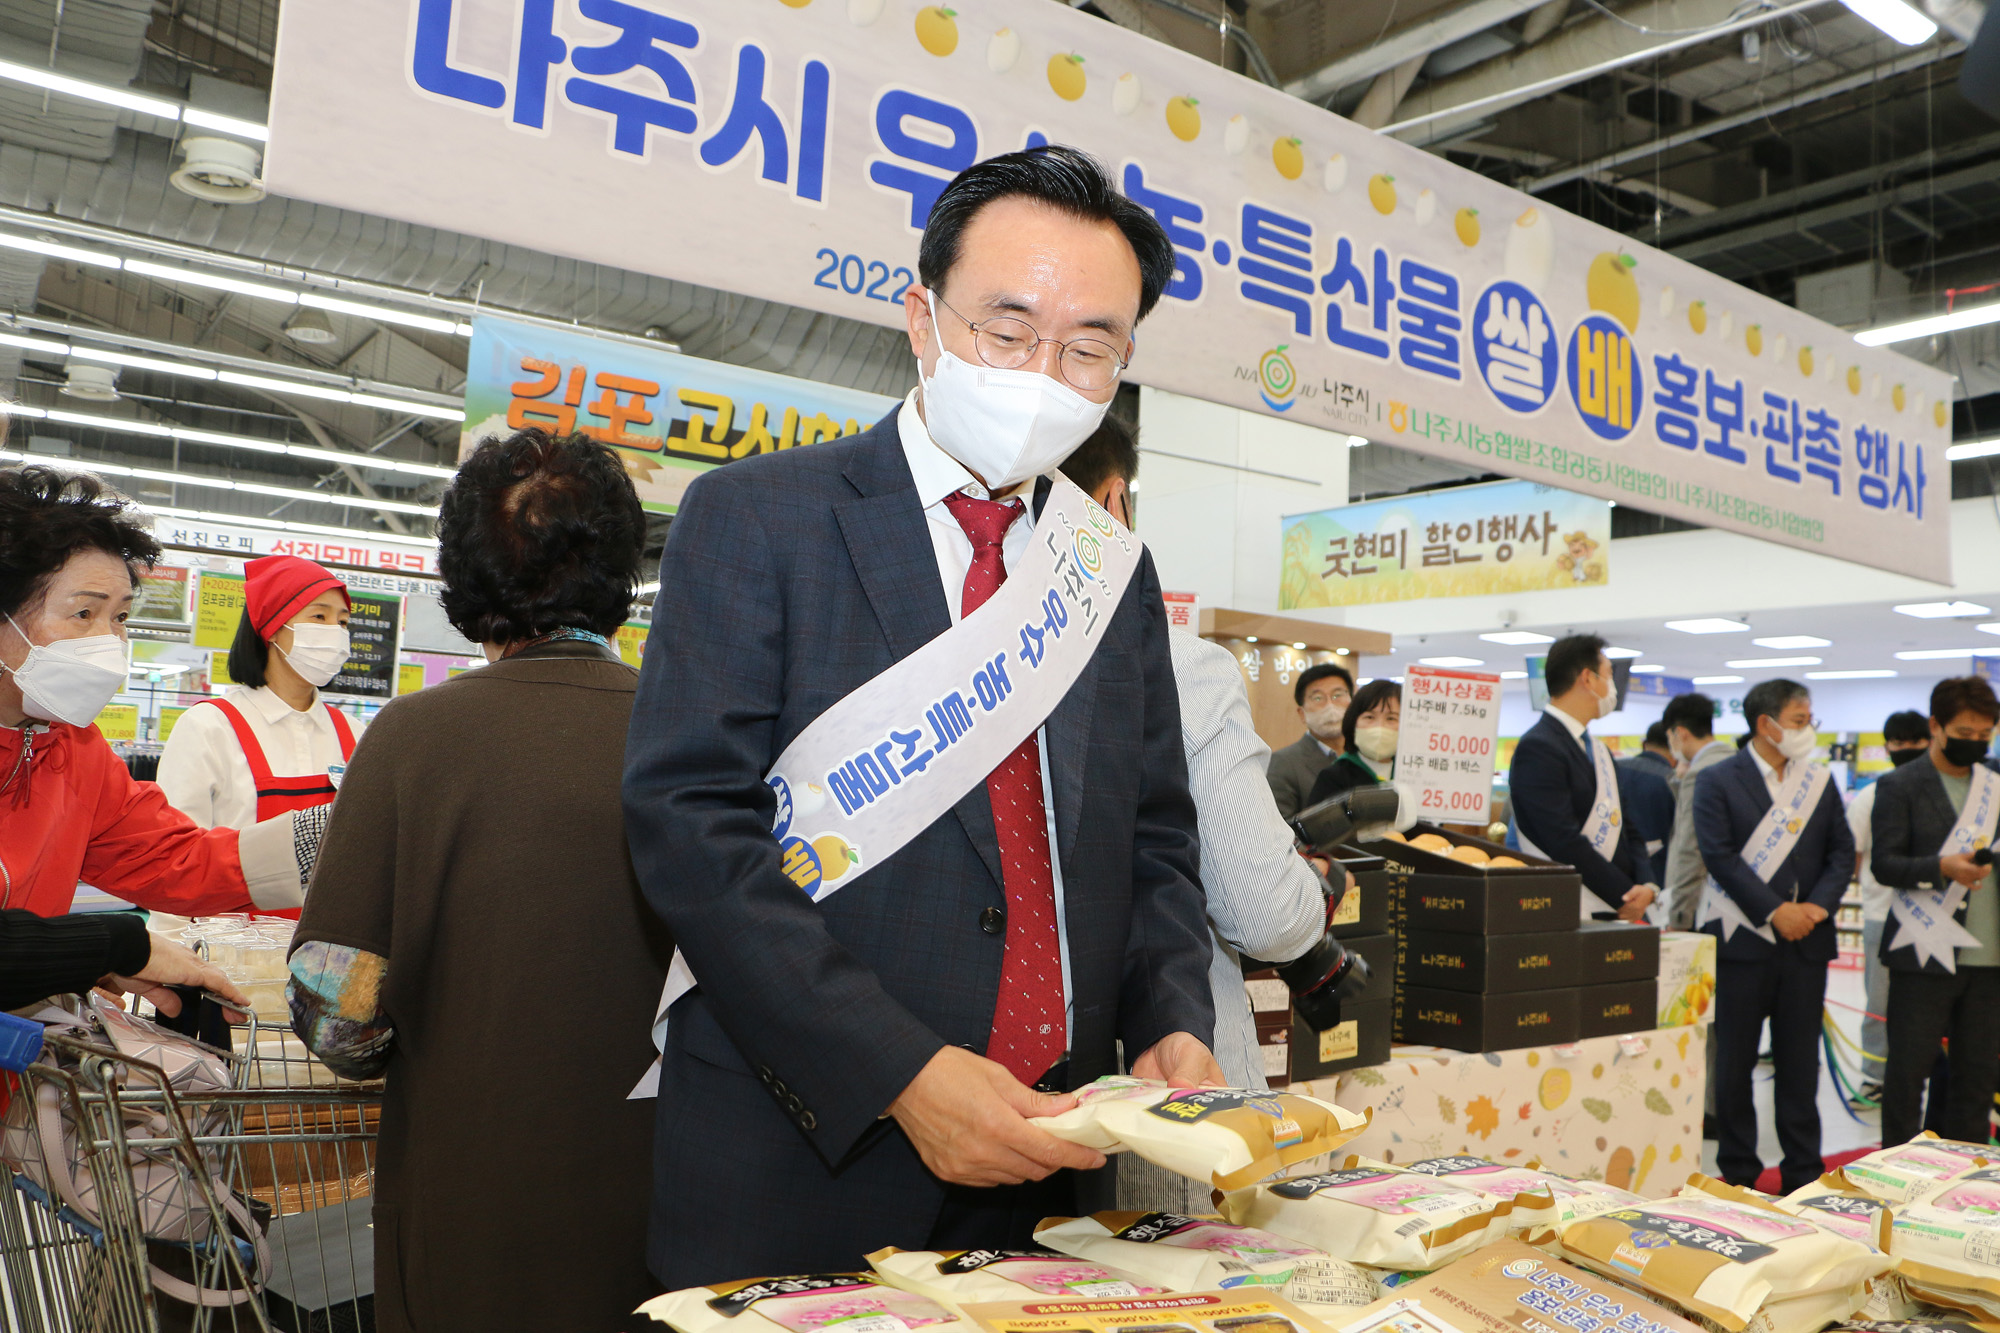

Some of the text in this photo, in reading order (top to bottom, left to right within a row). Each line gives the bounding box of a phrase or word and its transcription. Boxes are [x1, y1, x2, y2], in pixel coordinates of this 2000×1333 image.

[413, 0, 829, 203] 나주시
[1483, 292, 1549, 404] 쌀
[1578, 324, 1633, 430] 배
[1654, 353, 1842, 497] 홍보·판촉
[1854, 424, 1927, 520] 행사
[507, 357, 664, 451] 김포
[1324, 378, 1370, 412] 나주시
[1322, 511, 1558, 580] 굿현미 할인행사
[1045, 532, 1100, 637] 나주시
[1017, 588, 1069, 669] 우수
[1241, 648, 1264, 682] 쌀
[1409, 699, 1488, 719] 나주배 7.5kg
[1412, 677, 1495, 702] 행사상품
[827, 652, 1013, 816] 농·특산물
[1429, 733, 1491, 756] 50,000
[1403, 755, 1425, 769] 나주
[1429, 757, 1450, 771] 배즙
[1422, 789, 1484, 812] 25,000
[1526, 1266, 1590, 1301] 나주시
[1581, 1293, 1624, 1320] 우수
